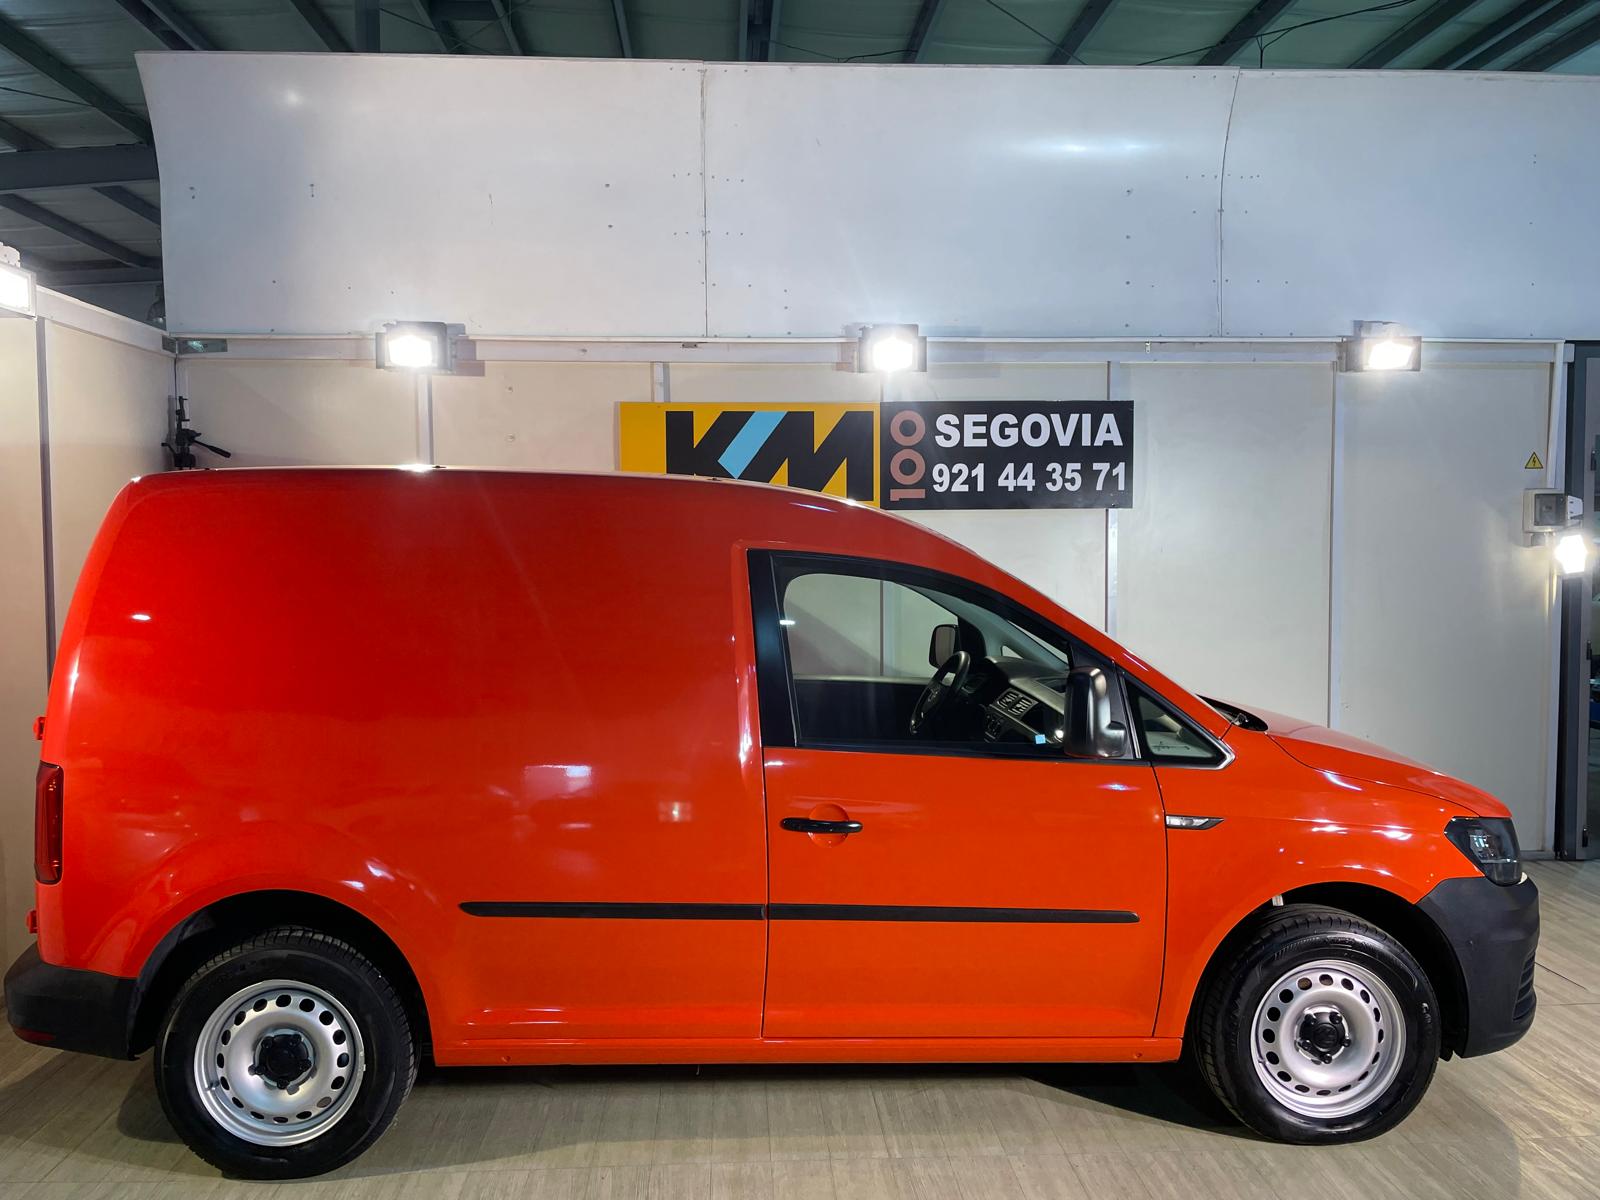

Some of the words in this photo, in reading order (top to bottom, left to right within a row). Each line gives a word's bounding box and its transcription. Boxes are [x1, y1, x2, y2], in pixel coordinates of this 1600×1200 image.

[666, 411, 874, 501] KM
[890, 410, 926, 501] 100
[935, 413, 1123, 448] SEGOVIA
[932, 462, 985, 492] 921
[998, 463, 1036, 491] 44
[1045, 462, 1082, 492] 35
[1092, 461, 1126, 491] 71
